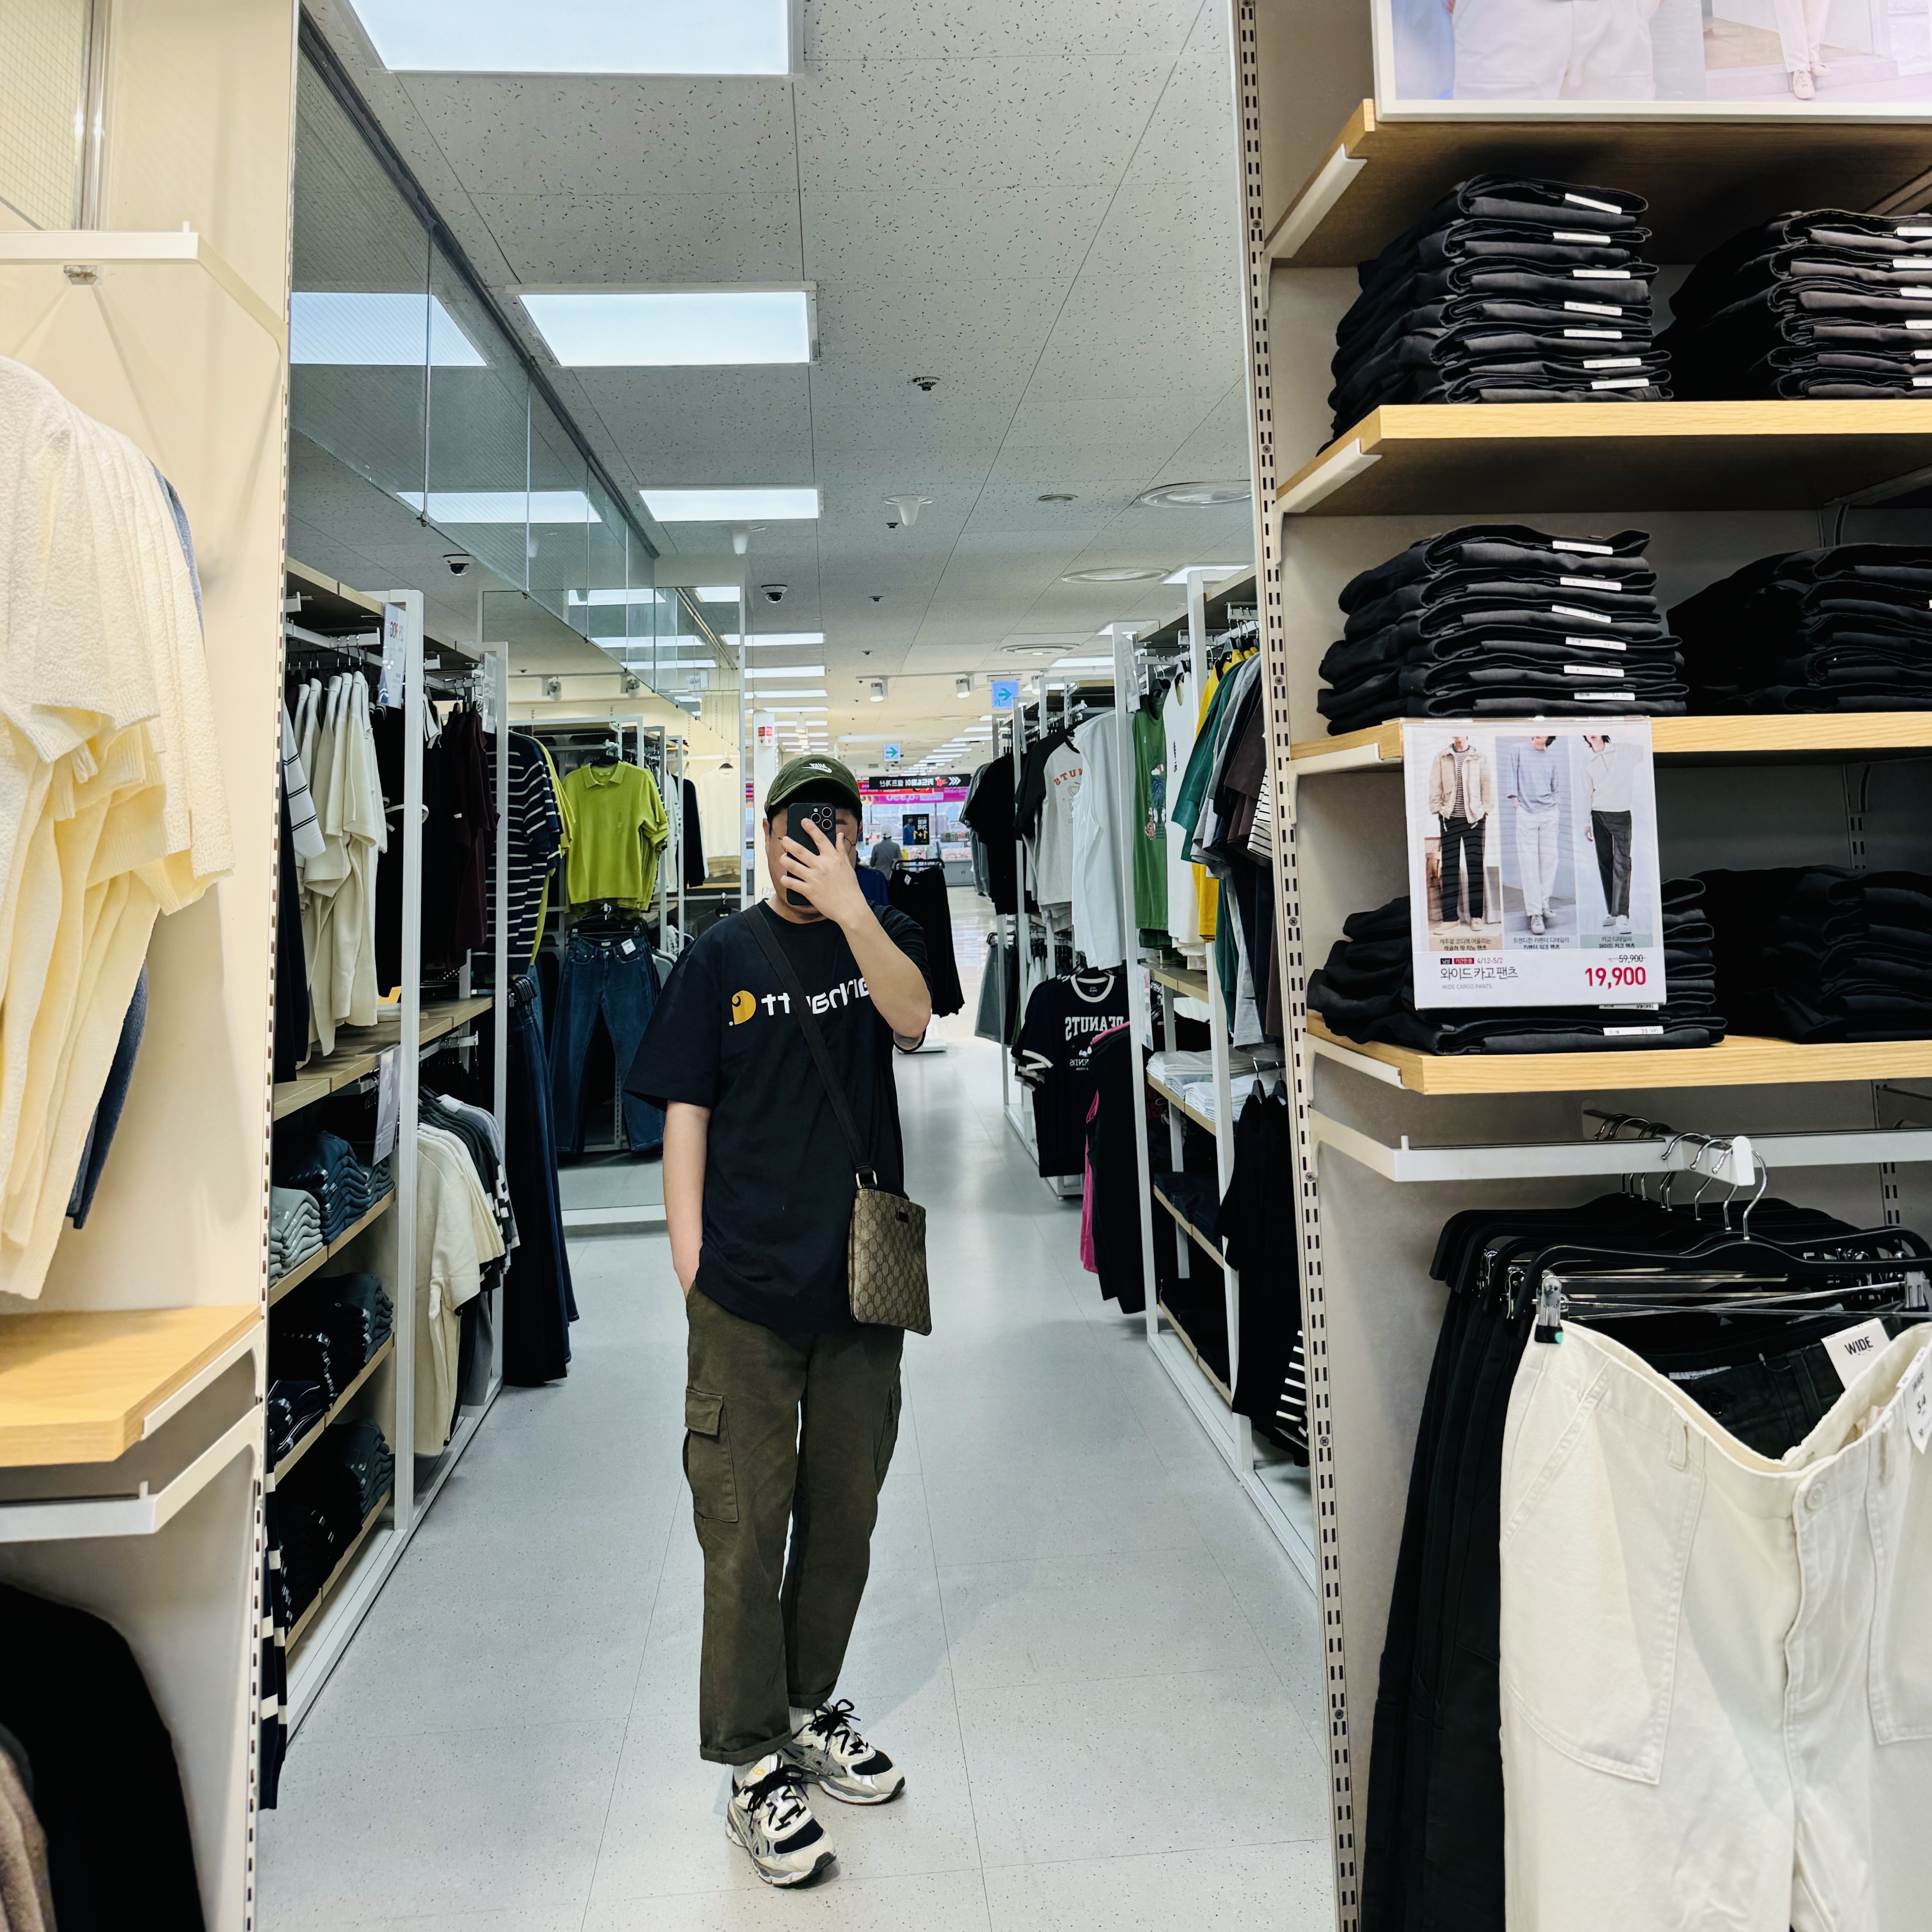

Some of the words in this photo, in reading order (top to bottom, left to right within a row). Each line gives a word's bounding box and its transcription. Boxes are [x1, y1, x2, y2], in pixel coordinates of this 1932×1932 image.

[1619, 954, 1644, 963] 59,900
[1440, 967, 1473, 980] 와이드
[1474, 967, 1496, 980] 카고
[1496, 966, 1518, 979] 팬츠
[1585, 967, 1646, 989] 19,900
[1844, 1336, 1874, 1355] WIDE
